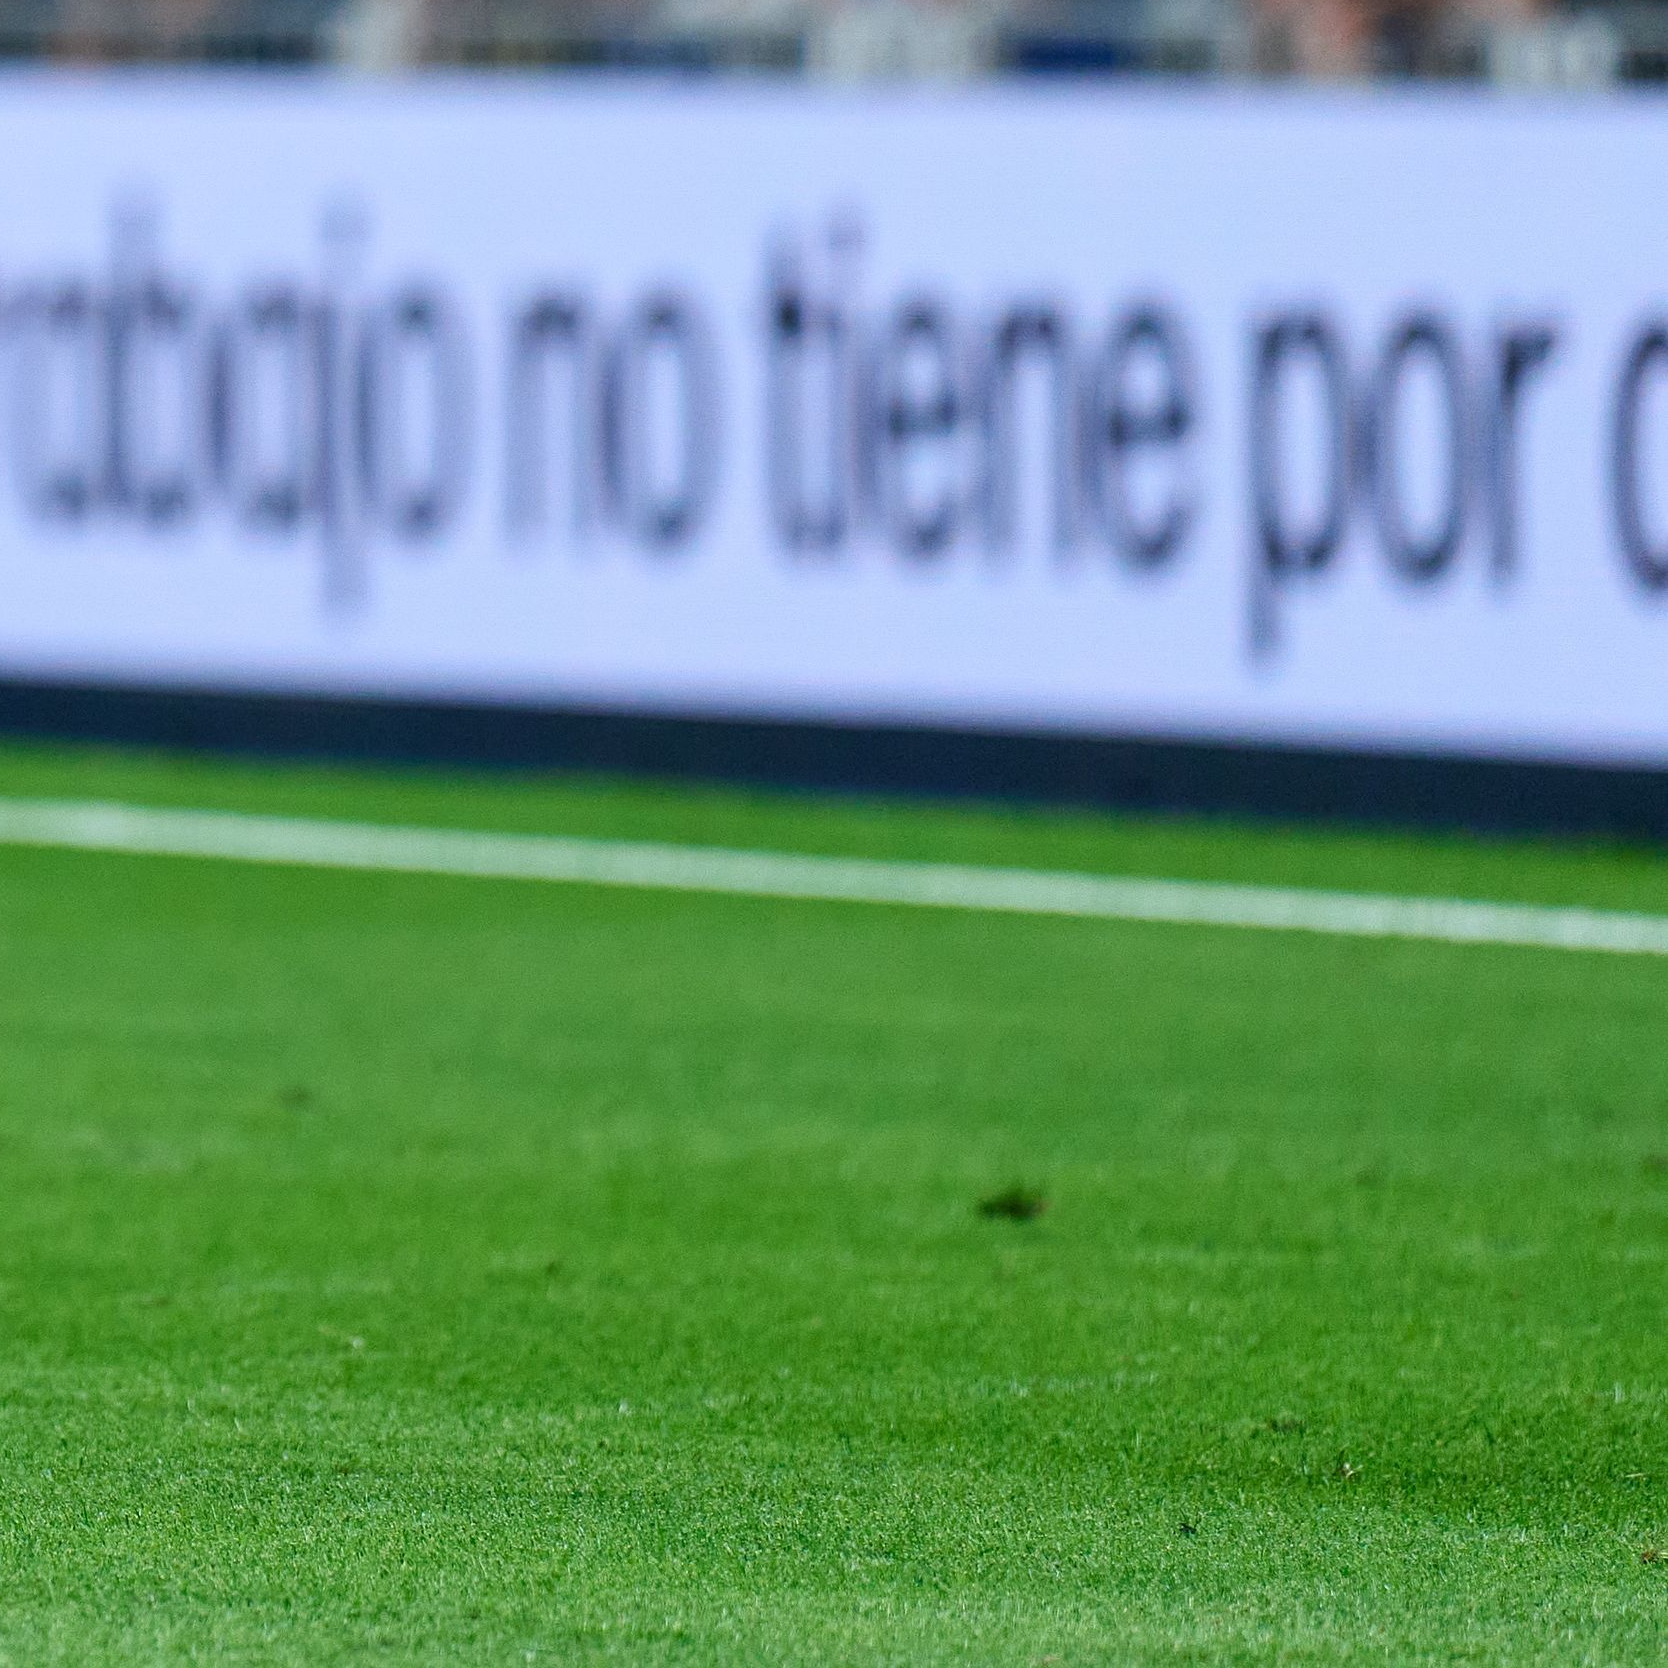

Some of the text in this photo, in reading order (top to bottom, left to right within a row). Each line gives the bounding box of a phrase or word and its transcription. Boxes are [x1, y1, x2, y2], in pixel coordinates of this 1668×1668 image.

[506, 290, 722, 552] no
[762, 217, 1200, 572] tiene
[1246, 302, 1561, 664] por
